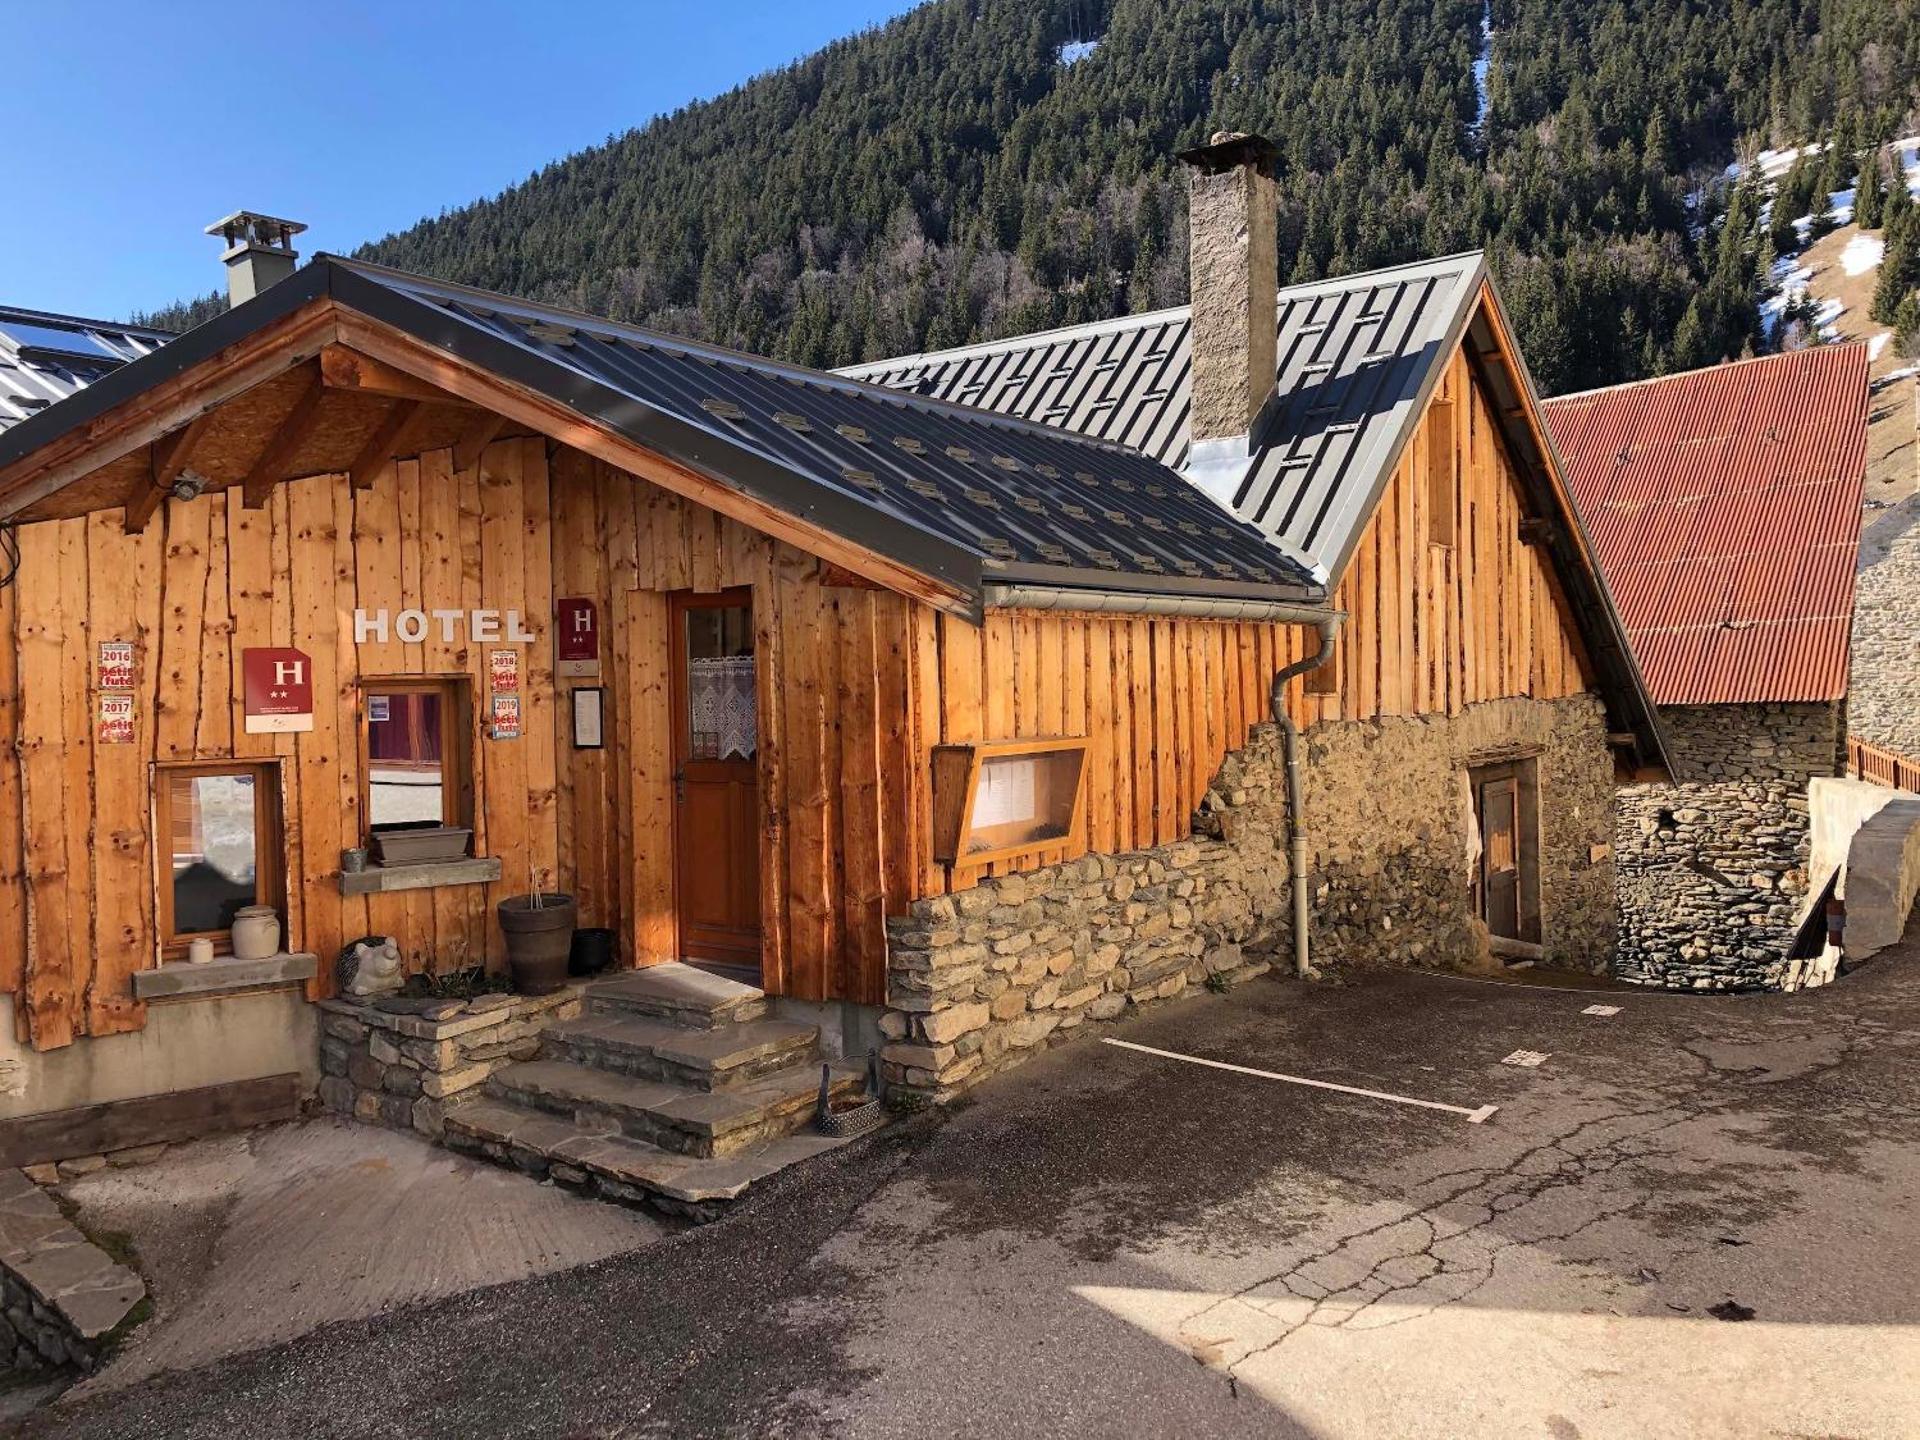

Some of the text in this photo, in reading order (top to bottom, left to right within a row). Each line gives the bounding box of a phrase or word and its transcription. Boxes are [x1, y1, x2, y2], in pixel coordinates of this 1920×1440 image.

[354, 609, 536, 643] HOTEL
[573, 609, 592, 632] H
[103, 651, 130, 661] 2016
[273, 661, 304, 686] H
[103, 703, 130, 713] 2017
[496, 700, 517, 710] 2019
